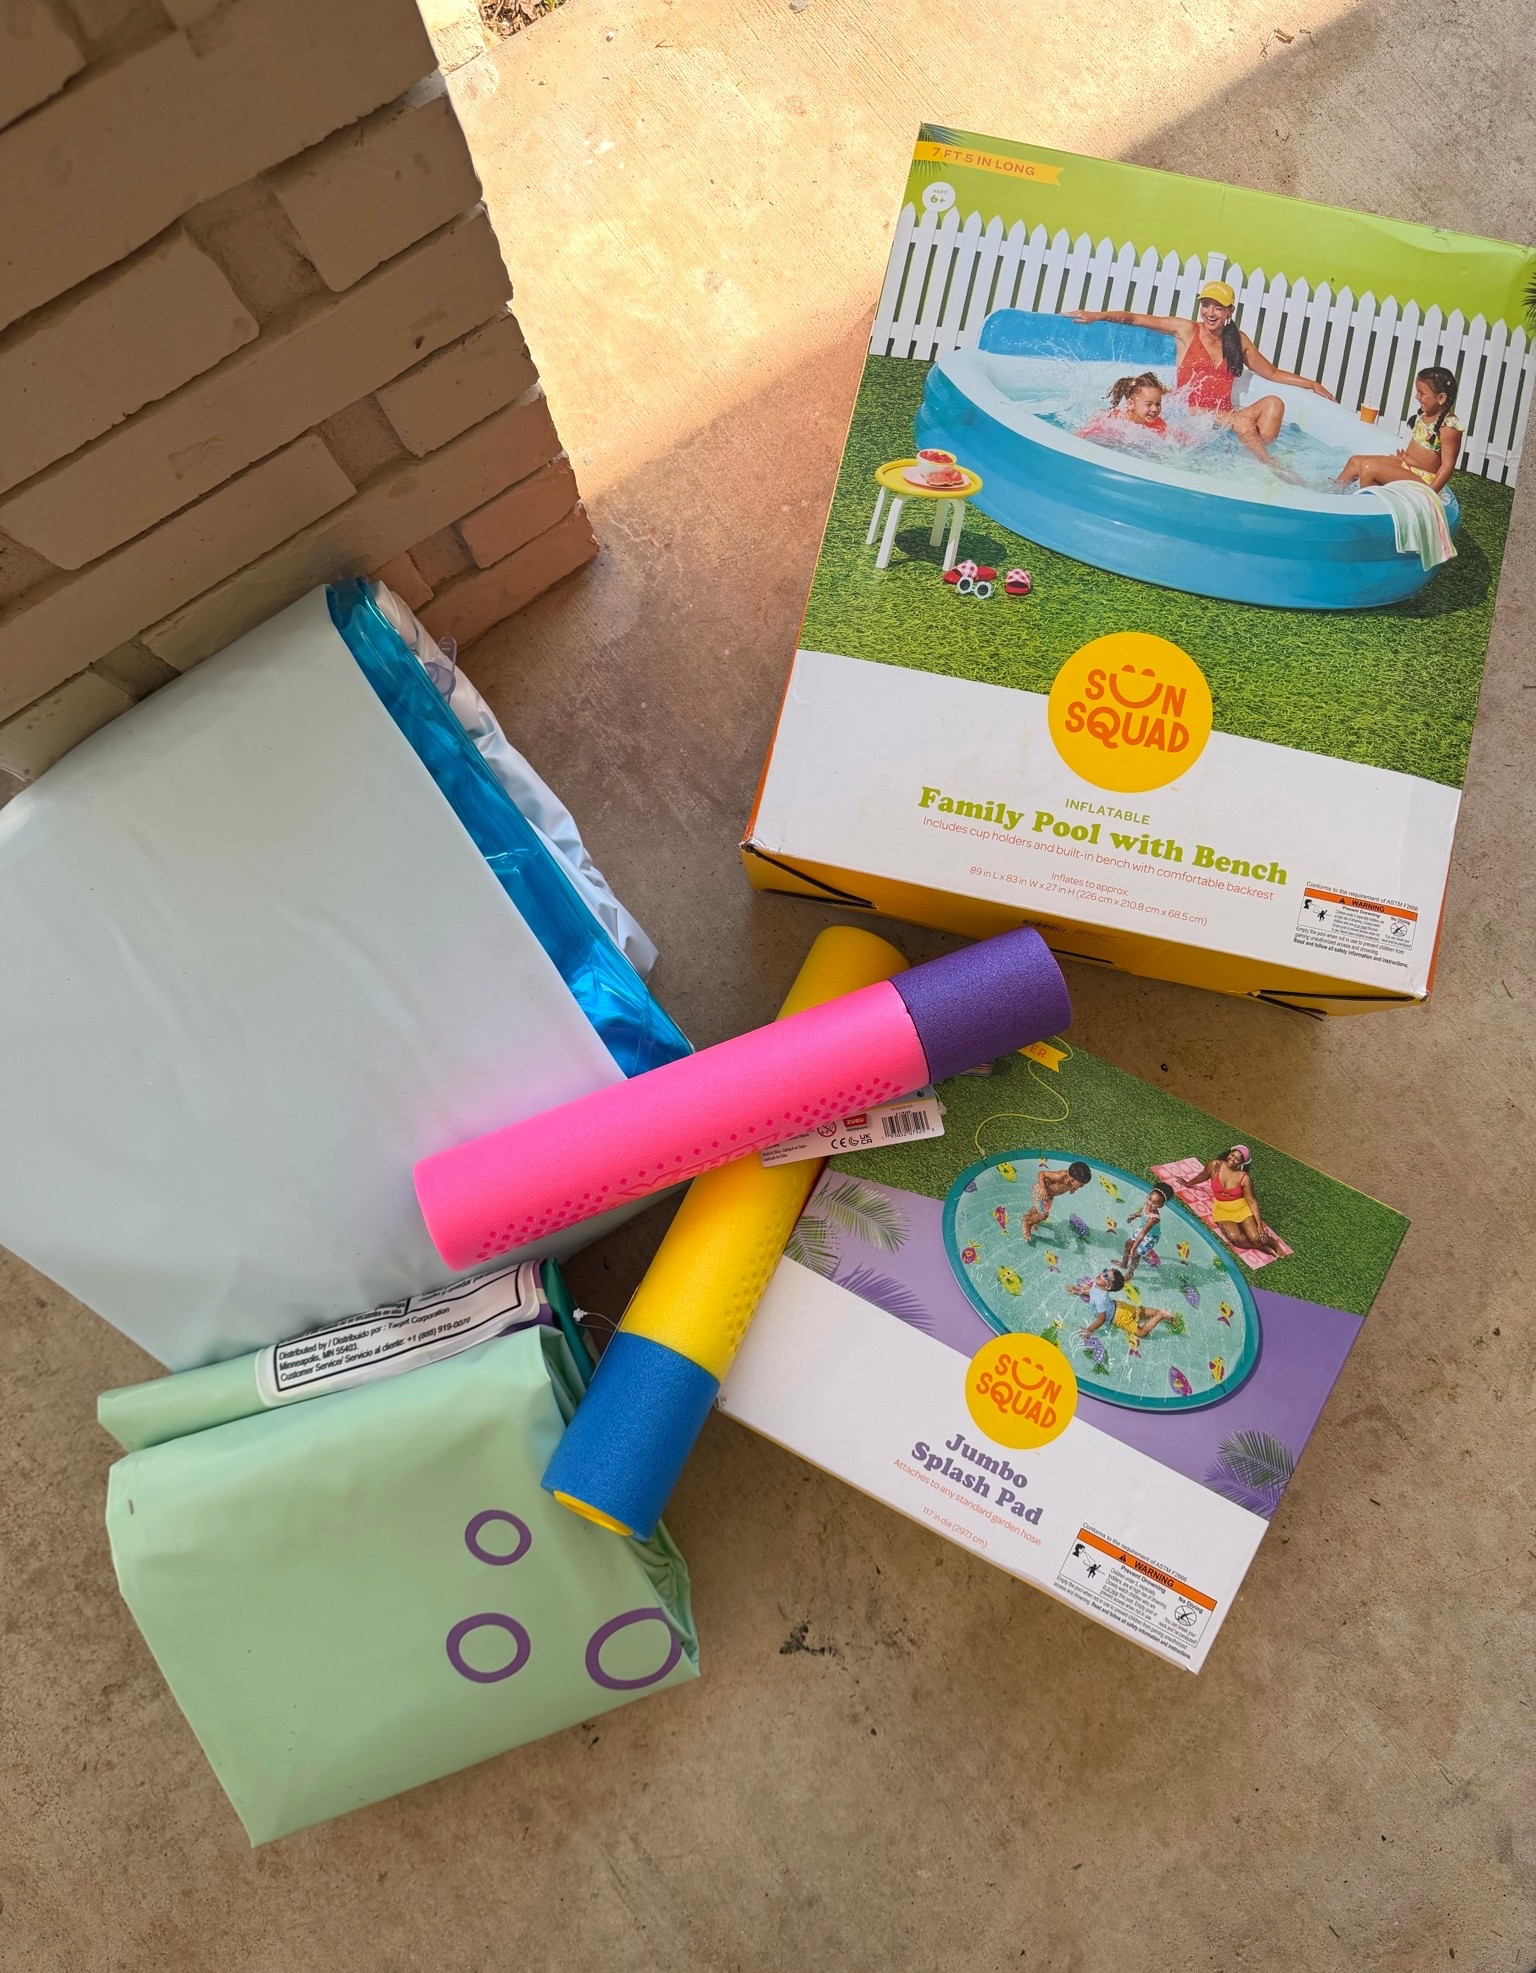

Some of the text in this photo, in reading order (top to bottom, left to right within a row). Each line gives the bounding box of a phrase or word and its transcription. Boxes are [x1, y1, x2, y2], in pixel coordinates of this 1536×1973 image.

[932, 147, 1035, 176] 7 FT 5 IN LONG
[930, 195, 946, 204] 6+
[1085, 664, 1187, 717] SUN
[1064, 701, 1190, 753] SQUAD
[918, 786, 1287, 885] Family Pool with Bench
[1065, 798, 1151, 825] INFLATABLE
[923, 816, 1274, 901] Includes cup holders and built-in bench with comfortable backrest
[969, 866, 982, 876] 89
[983, 868, 991, 878] in
[992, 871, 998, 880] L
[1006, 874, 1018, 884] 83
[1018, 877, 1027, 886] in
[1029, 879, 1038, 888] W
[1045, 883, 1057, 892] 27
[1057, 885, 1066, 894] in
[1067, 887, 1076, 896] H
[1076, 889, 1097, 901] (226
[1098, 896, 1113, 904] cm
[1120, 899, 1144, 911] 210.8
[1145, 905, 1160, 915] cm
[1168, 909, 1188, 921] 68.5
[1188, 915, 1208, 927] cm)
[1051, 872, 1129, 897] Inflates to approx.
[1351, 900, 1385, 912] WARNING
[846, 1117, 864, 1125] ZURU
[279, 1343, 318, 1360] Distributed
[317, 1340, 328, 1351] by
[369, 1326, 383, 1336] por
[387, 1317, 410, 1330] Target
[411, 1306, 450, 1326] Corporation
[321, 1348, 335, 1358] MN
[280, 1365, 314, 1382] Customer
[344, 1347, 373, 1363] Servicio
[373, 1345, 382, 1354] al
[406, 1334, 417, 1342] +1
[994, 1353, 1062, 1404] SUN
[976, 1372, 1057, 1428] SQUAD
[911, 1441, 1044, 1526] Splash Pad
[945, 1433, 1028, 1488] Jumbo
[892, 1458, 1041, 1546] Attaches to any standard garden hose
[922, 1506, 934, 1515] 117
[933, 1512, 941, 1522] in
[940, 1515, 952, 1528] dia
[972, 1533, 988, 1549] cm)
[1120, 1565, 1166, 1594] Prevent Drowning
[1133, 1560, 1175, 1588] WARNING
